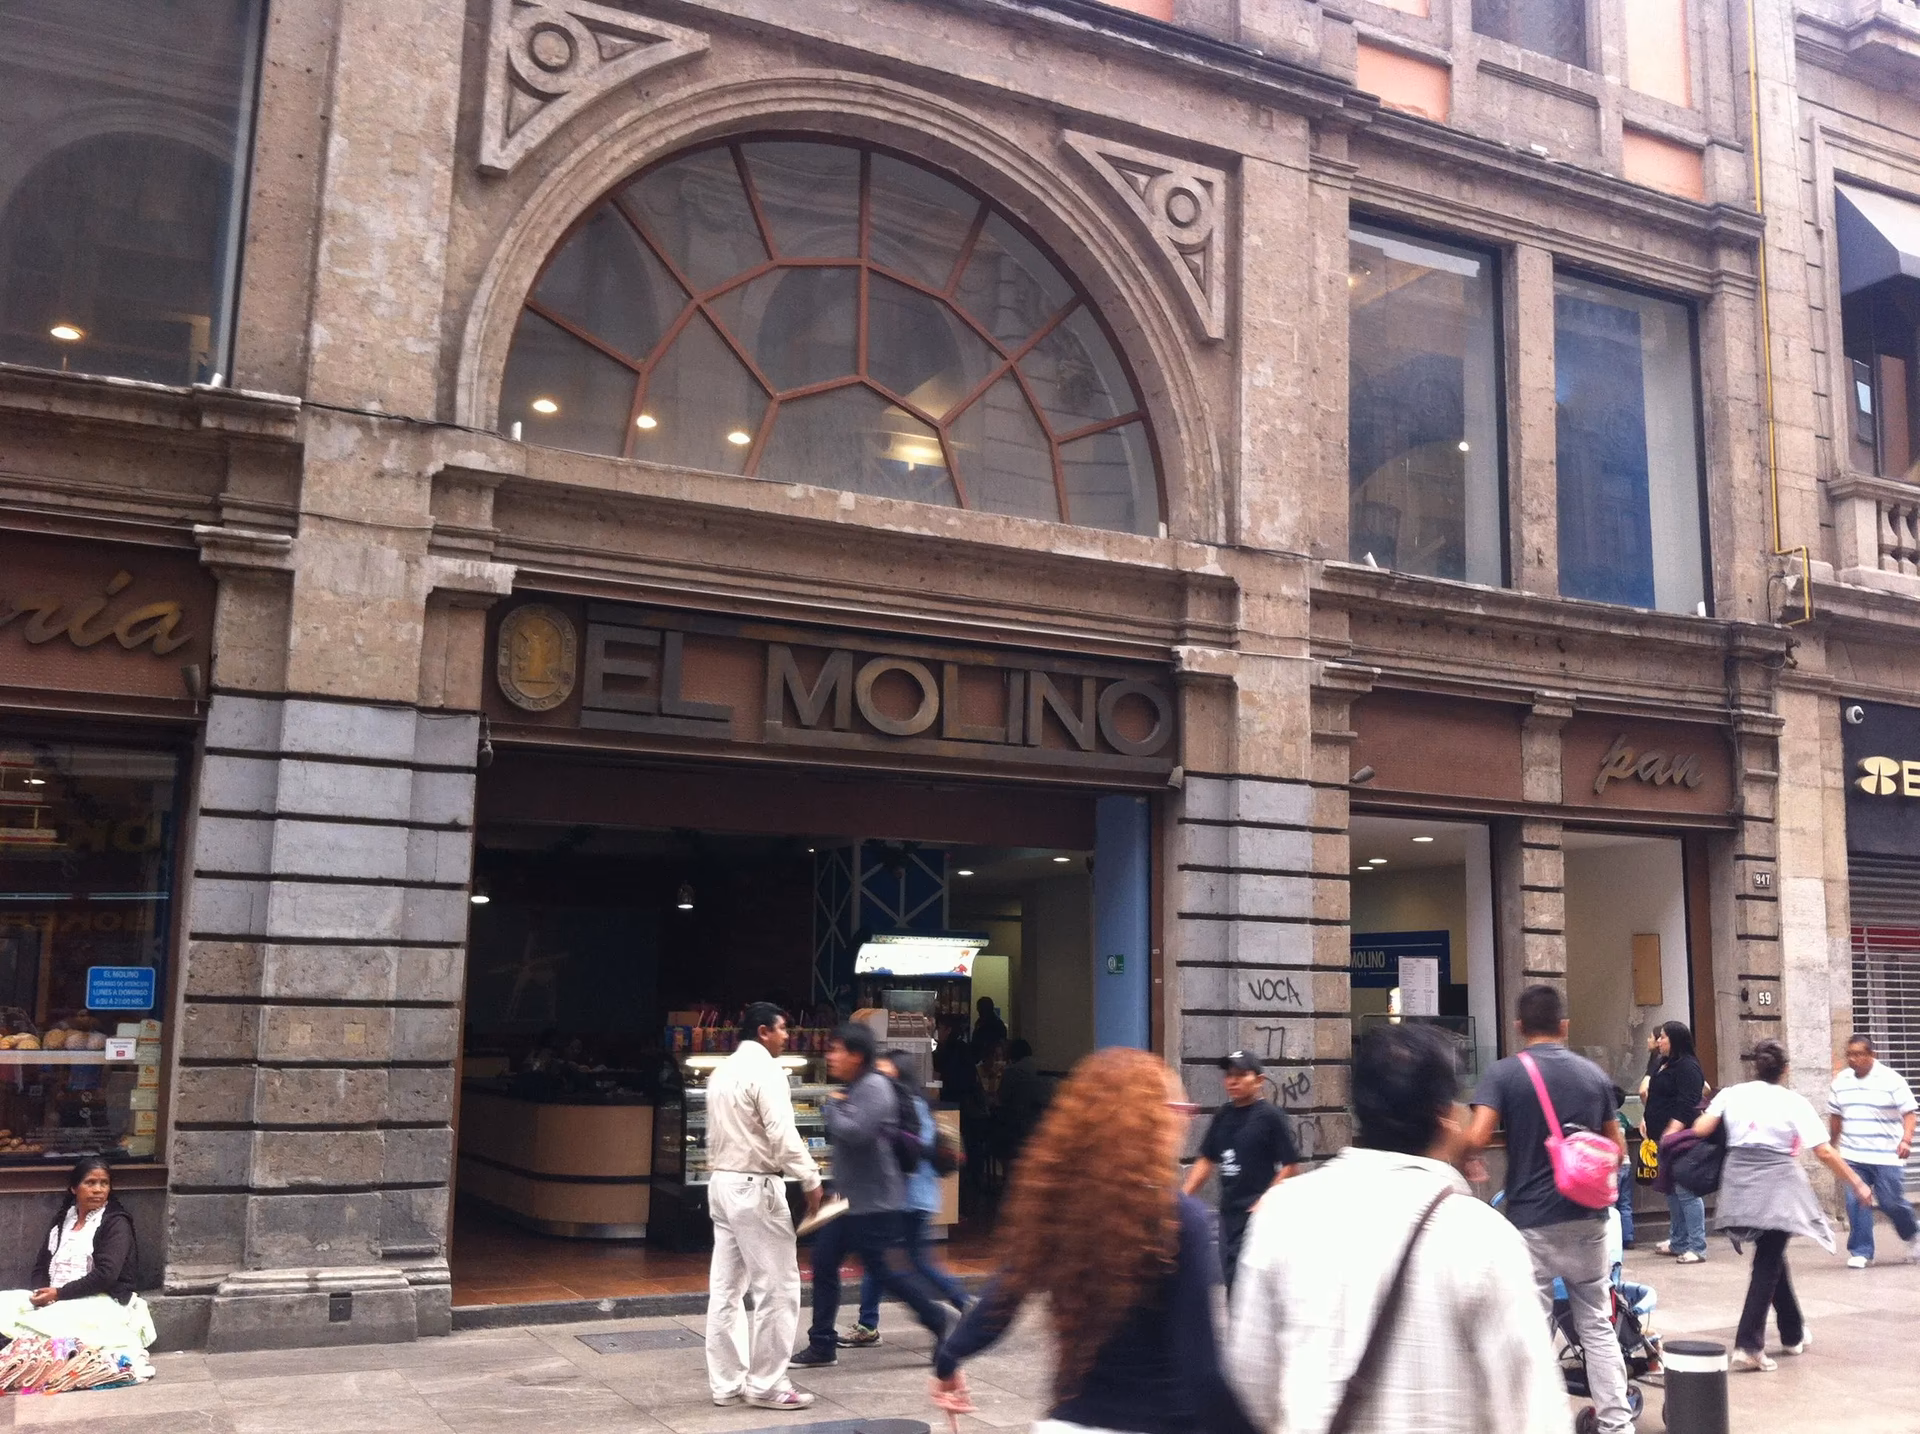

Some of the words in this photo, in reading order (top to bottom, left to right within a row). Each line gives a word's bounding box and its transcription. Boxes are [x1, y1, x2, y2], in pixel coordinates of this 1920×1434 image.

[582, 622, 735, 723] EL
[765, 642, 1173, 757] MOLINO
[1594, 733, 1704, 794] pan
[112, 970, 139, 979] MOLINO
[1758, 991, 1772, 1005] 59
[1637, 1166, 1658, 1179] LEO
